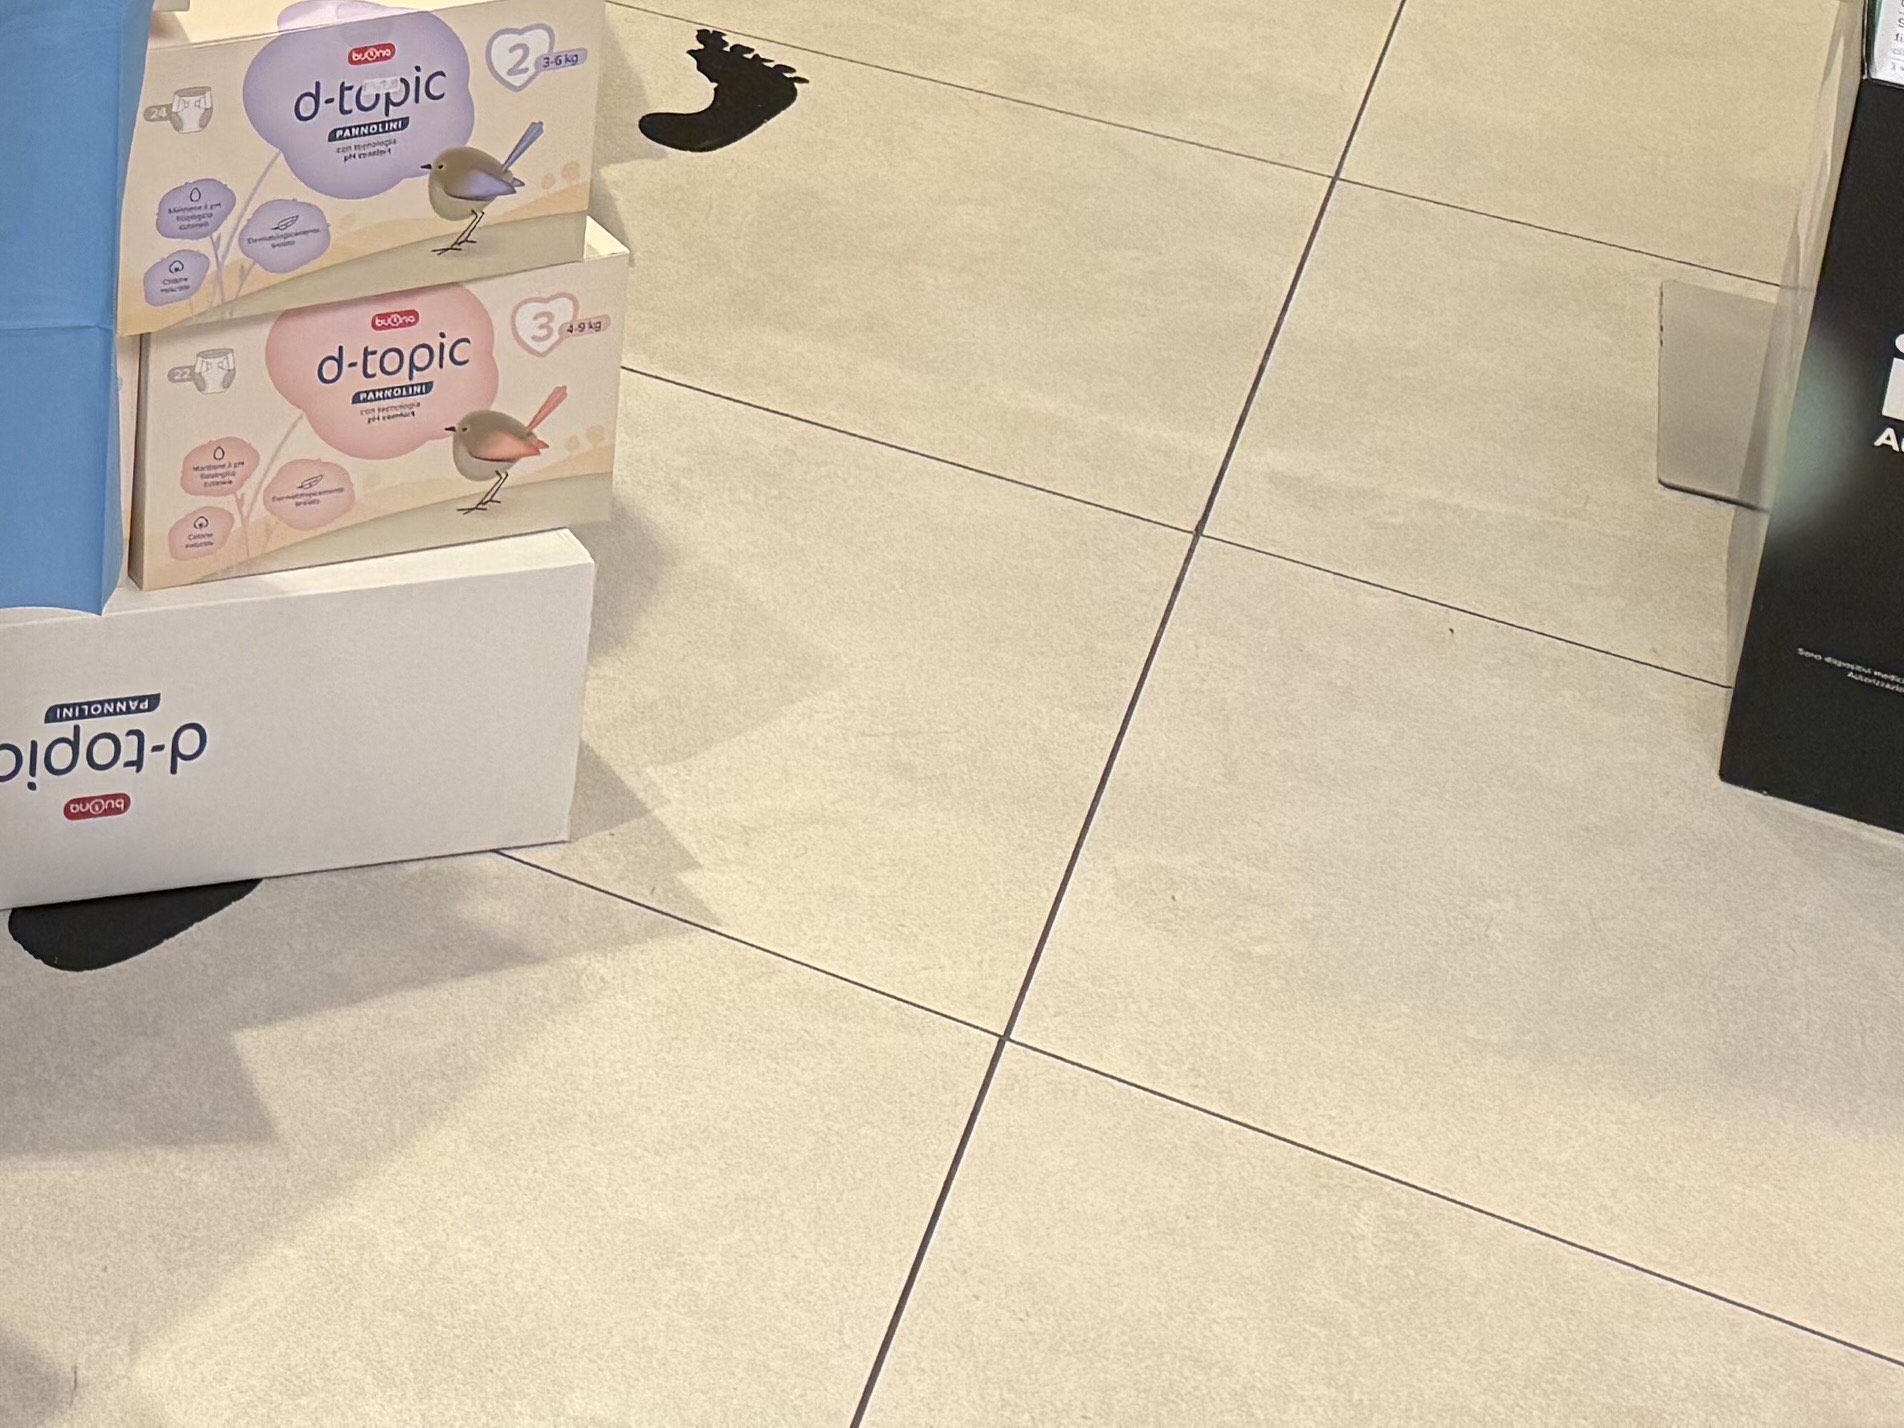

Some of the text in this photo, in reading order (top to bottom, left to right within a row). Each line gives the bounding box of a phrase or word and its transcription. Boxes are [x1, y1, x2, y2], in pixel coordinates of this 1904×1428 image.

[505, 42, 533, 77] 2
[293, 65, 447, 126] d-topic
[335, 117, 403, 140] PANNOLINI
[317, 332, 471, 390] d-topic
